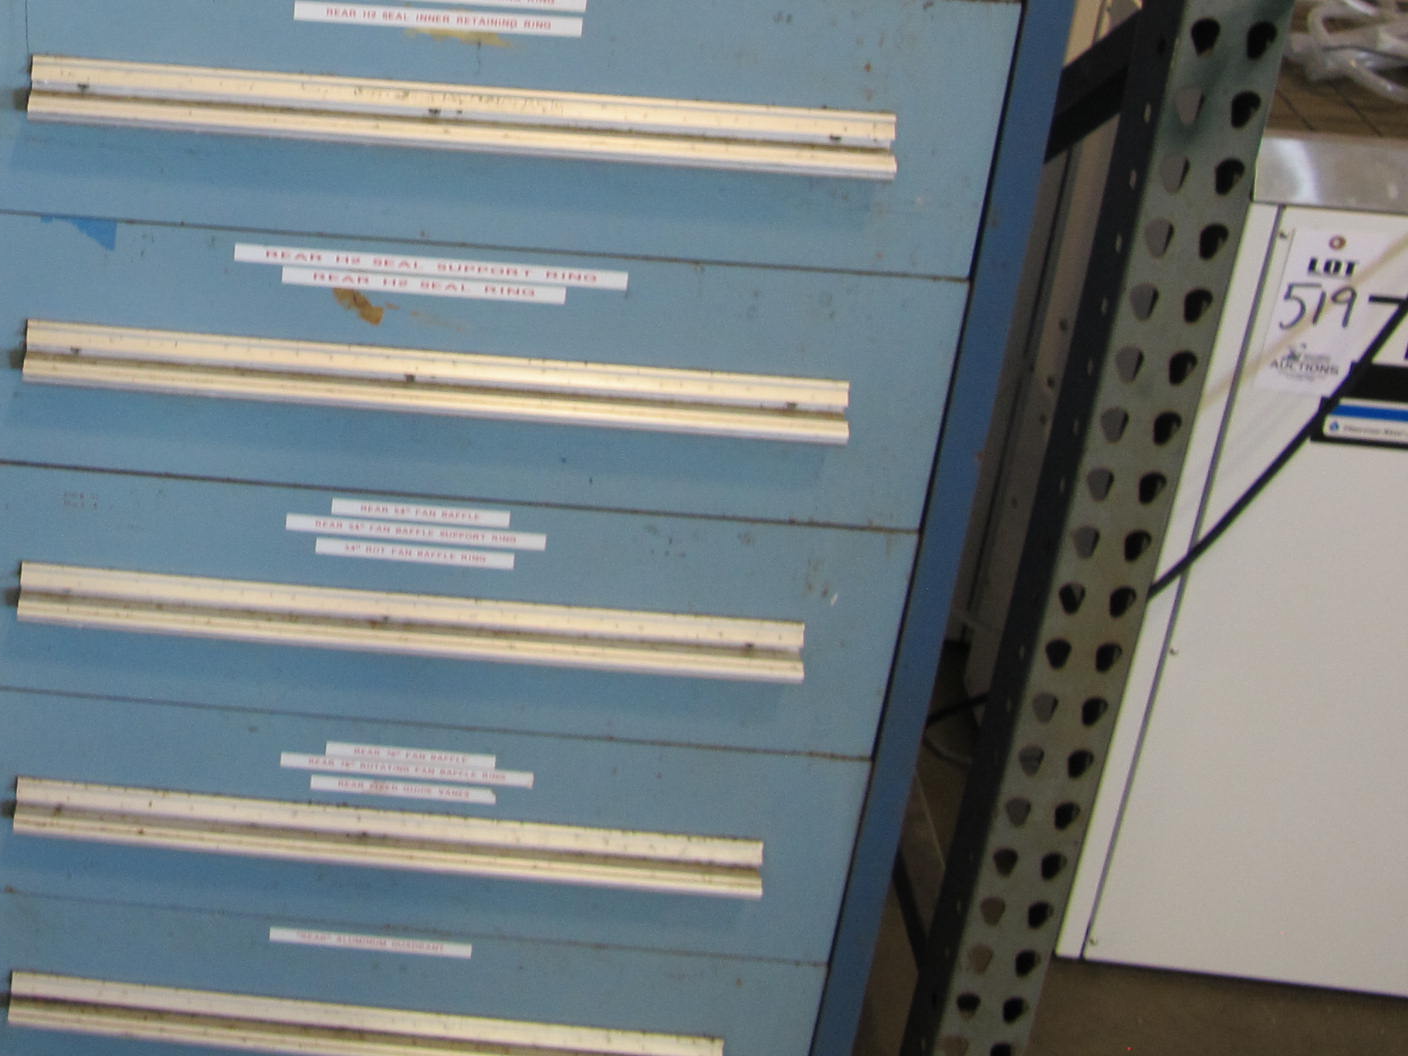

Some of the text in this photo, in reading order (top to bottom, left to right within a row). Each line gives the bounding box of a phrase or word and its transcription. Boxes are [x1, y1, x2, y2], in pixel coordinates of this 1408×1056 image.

[326, 8, 357, 19] REAR
[382, 10, 410, 22] SEAL
[415, 12, 450, 25] INNER
[456, 14, 518, 29] RETAINING
[523, 18, 552, 30] RING
[265, 248, 323, 263] REAR
[372, 256, 422, 271] SEAL
[436, 260, 531, 278] SUPPORT
[545, 268, 598, 283] RING
[1308, 257, 1358, 277] LOT
[312, 271, 370, 286] REAR
[420, 278, 471, 293] SEAL
[484, 283, 536, 298] RING
[1279, 282, 1358, 330] 519
